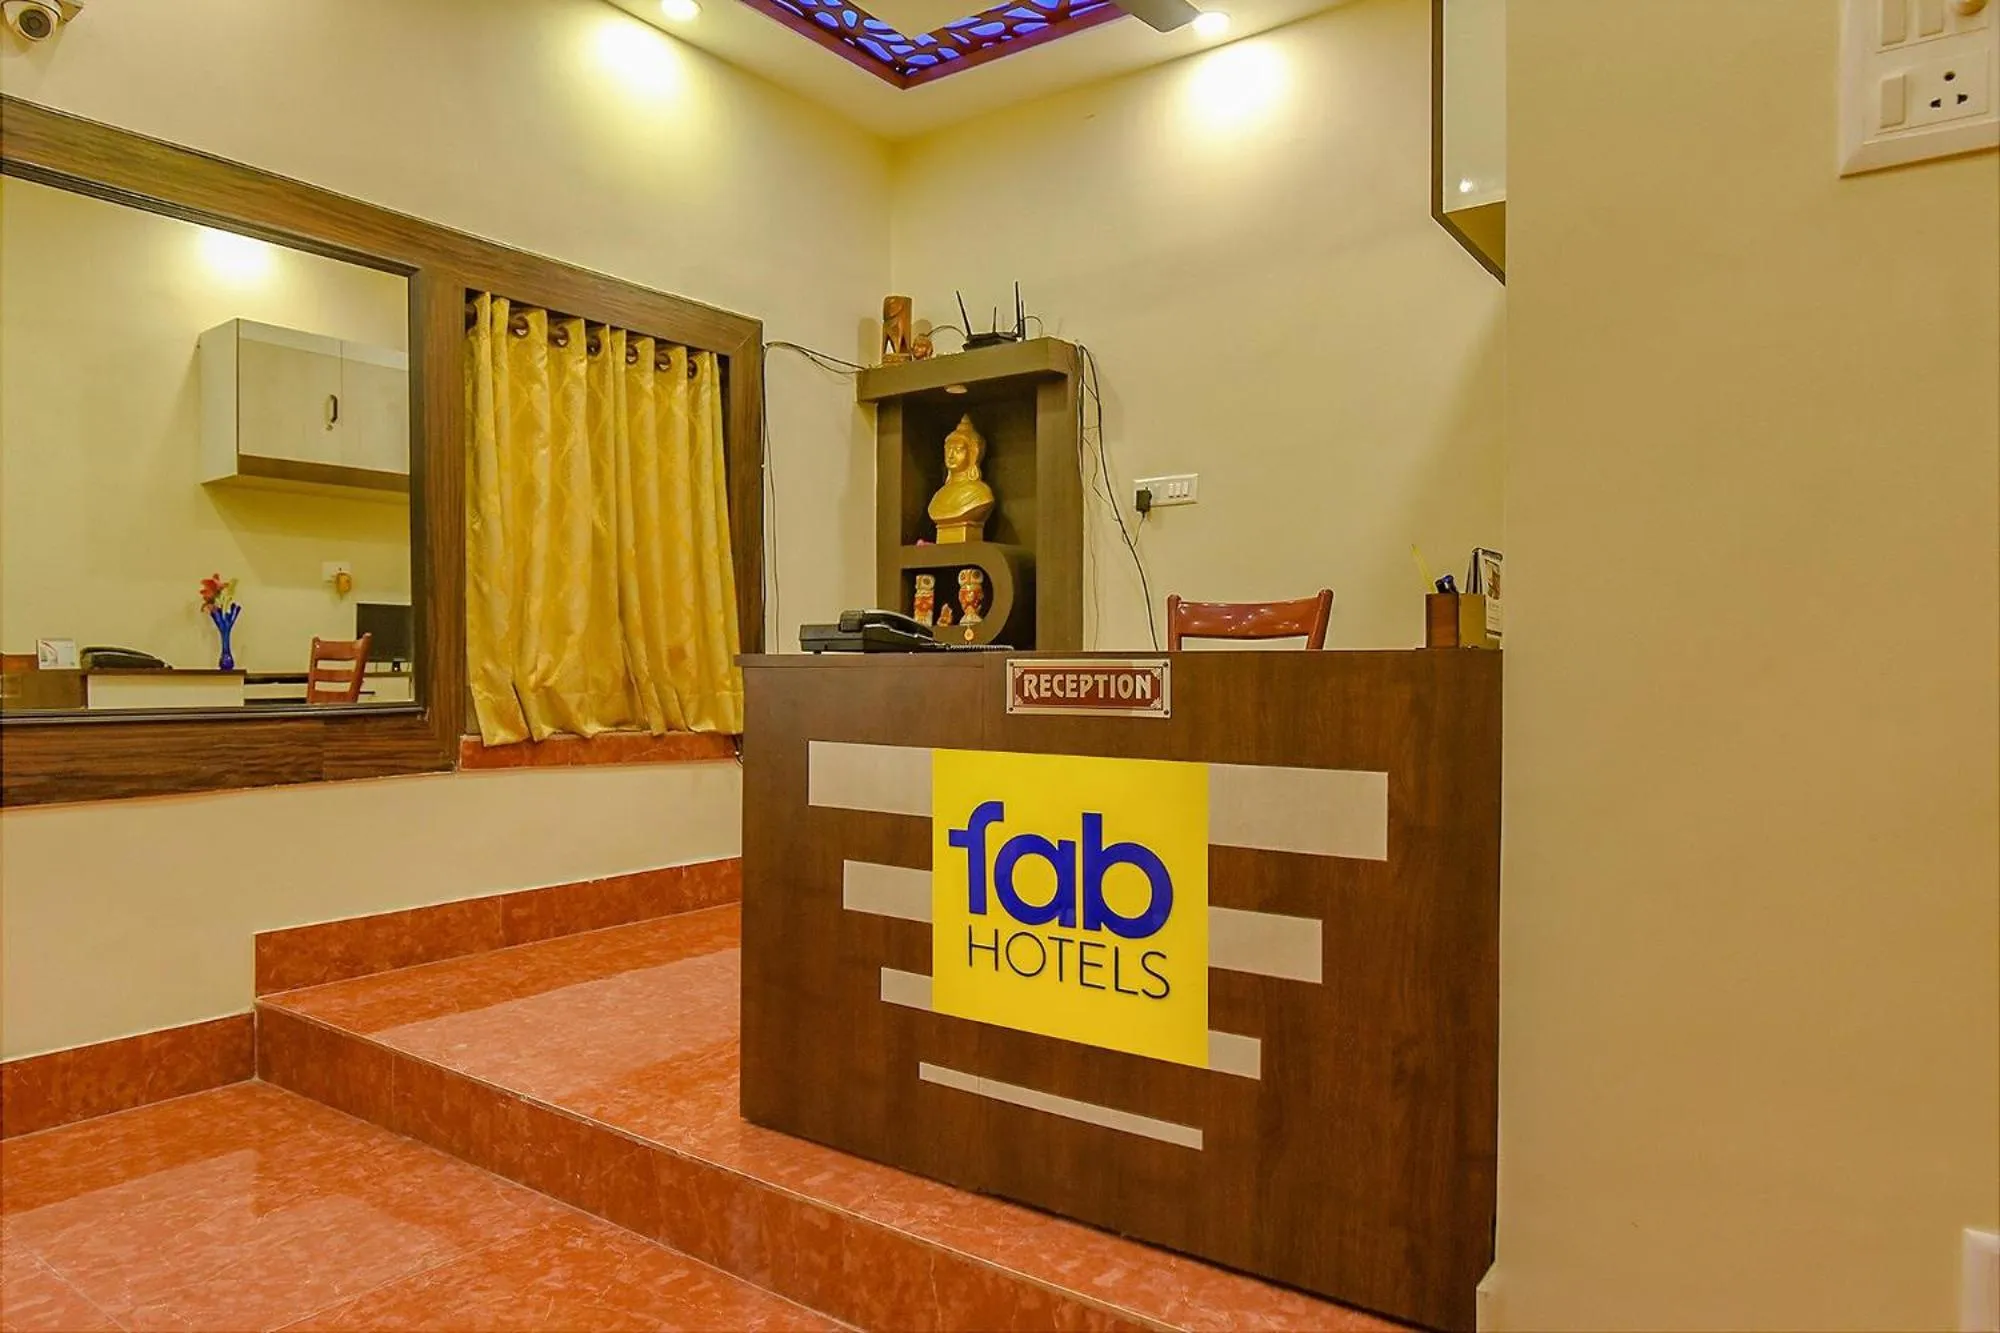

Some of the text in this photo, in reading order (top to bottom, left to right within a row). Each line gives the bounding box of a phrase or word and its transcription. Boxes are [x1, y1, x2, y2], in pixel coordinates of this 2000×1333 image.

[1023, 673, 1152, 700] RECEPTION
[948, 800, 1174, 940] fab
[967, 925, 1171, 1000] HOTELS
